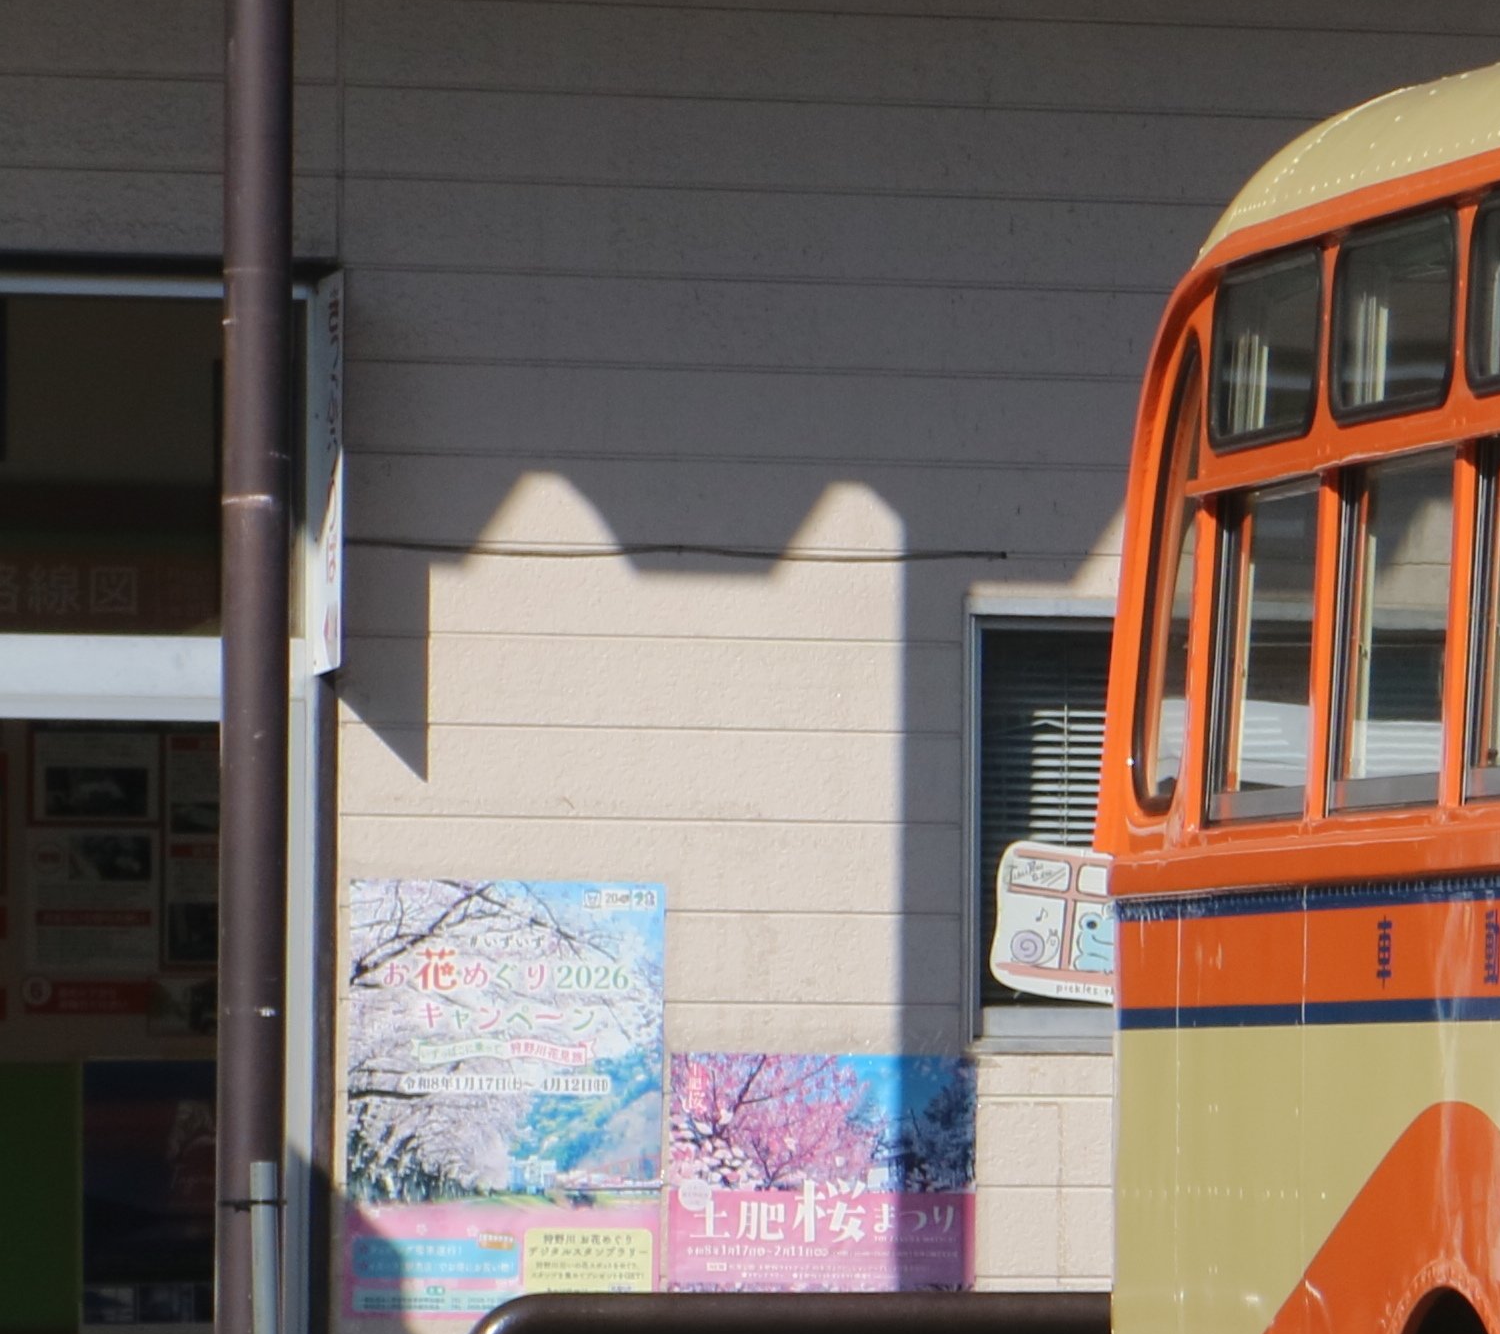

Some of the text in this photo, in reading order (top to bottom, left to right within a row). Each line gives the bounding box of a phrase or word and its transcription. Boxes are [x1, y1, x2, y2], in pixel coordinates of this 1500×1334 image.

[420, 1002, 595, 1031] キャンペーン
[689, 1178, 955, 1243] 土肥桜まつり
